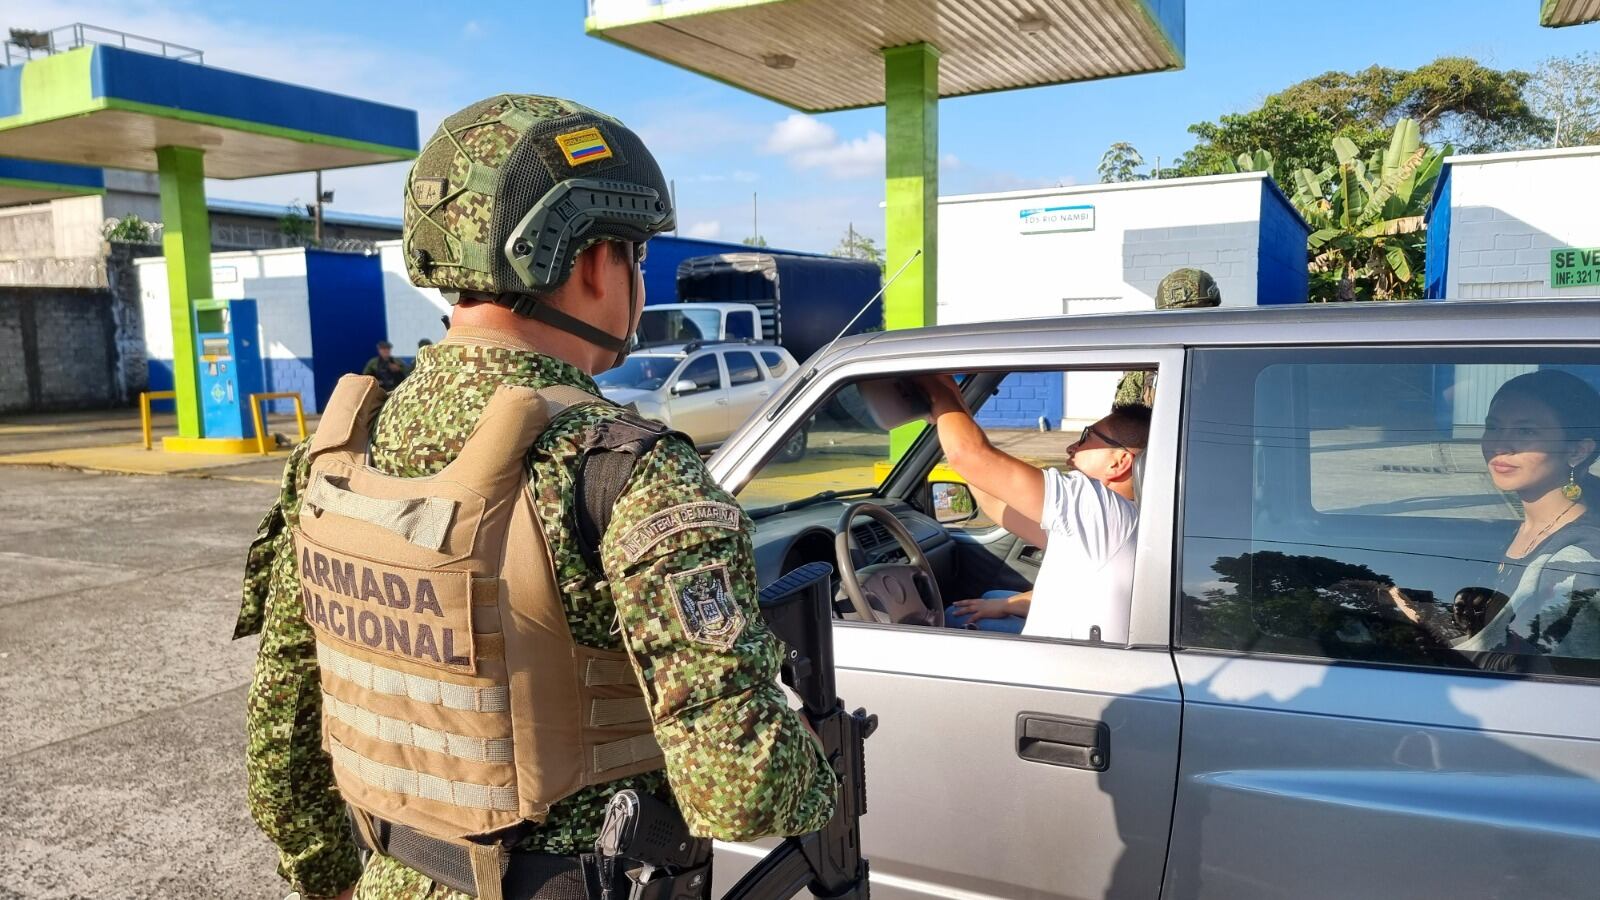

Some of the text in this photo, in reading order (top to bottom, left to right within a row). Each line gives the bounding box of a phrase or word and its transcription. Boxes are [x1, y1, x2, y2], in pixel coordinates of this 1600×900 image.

[1555, 251, 1576, 269] SE
[1555, 271, 1574, 286] INF:
[1576, 269, 1592, 284] 321
[624, 506, 735, 555] INFANTERIA DE MARINA
[302, 546, 444, 618] ARMADA
[303, 585, 471, 666] NACIONAL
